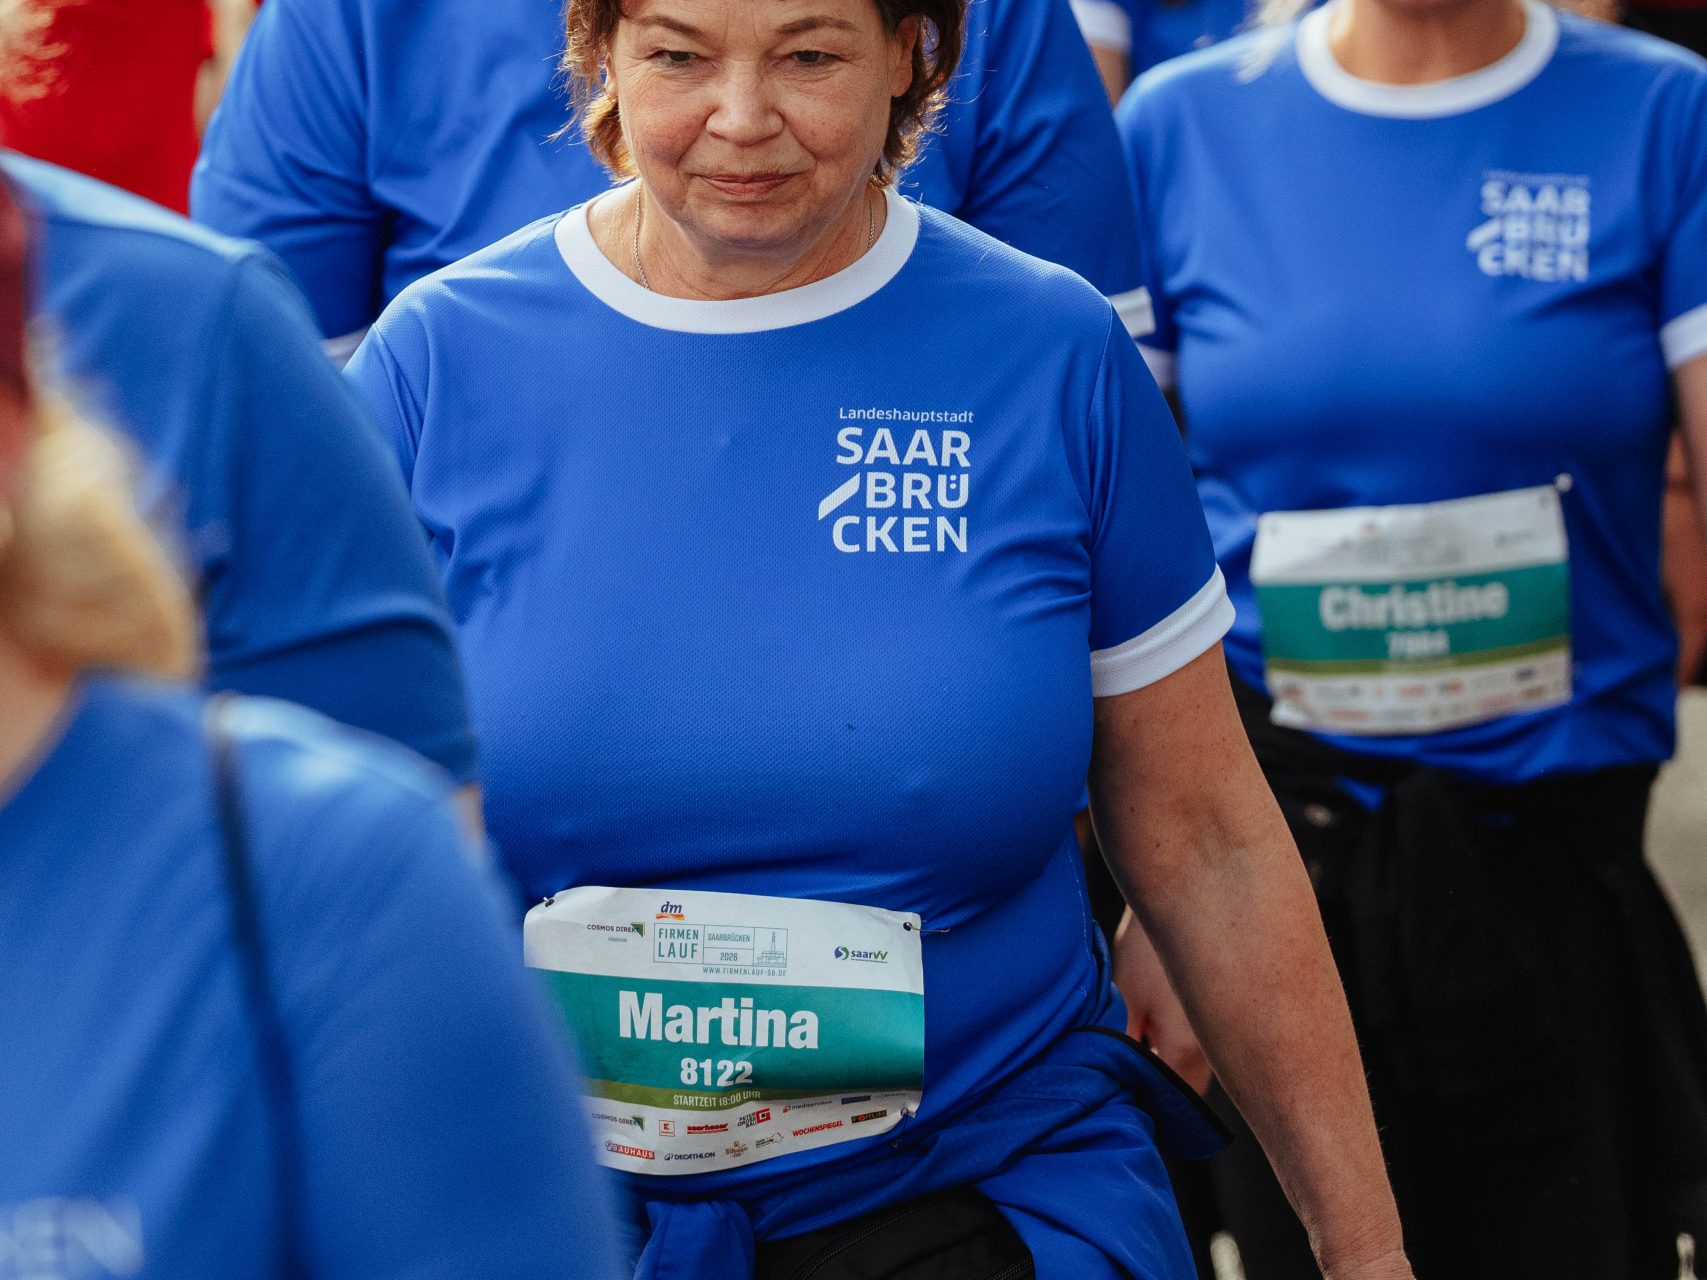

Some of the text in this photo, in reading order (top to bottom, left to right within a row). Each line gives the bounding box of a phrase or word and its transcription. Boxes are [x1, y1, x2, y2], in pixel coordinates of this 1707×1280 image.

[1481, 180, 1590, 216] SAAR
[839, 407, 974, 423] Landeshauptstadt
[836, 426, 971, 468] SAAR
[866, 471, 969, 509] BRÜ
[832, 515, 968, 553] CKEN
[1319, 581, 1509, 632] Christine
[660, 901, 683, 914] dm
[587, 924, 614, 932] COSMOS
[658, 928, 699, 940] FIRMEN
[707, 933, 751, 943] SAARBRÜCKEN
[658, 941, 698, 959] LAUF
[703, 966, 787, 977] WWW.FIRMENLAUF-SB.DE
[619, 990, 819, 1050] Martina
[680, 1057, 753, 1087] 8122
[673, 1090, 761, 1107] STARTZEIT 18:00 UHR
[592, 1113, 618, 1122] COSMOS
[792, 1120, 844, 1137] WOCHENSPIEGEL
[611, 1142, 656, 1160] BAUHAUS
[674, 1151, 716, 1161] DECATHLON
